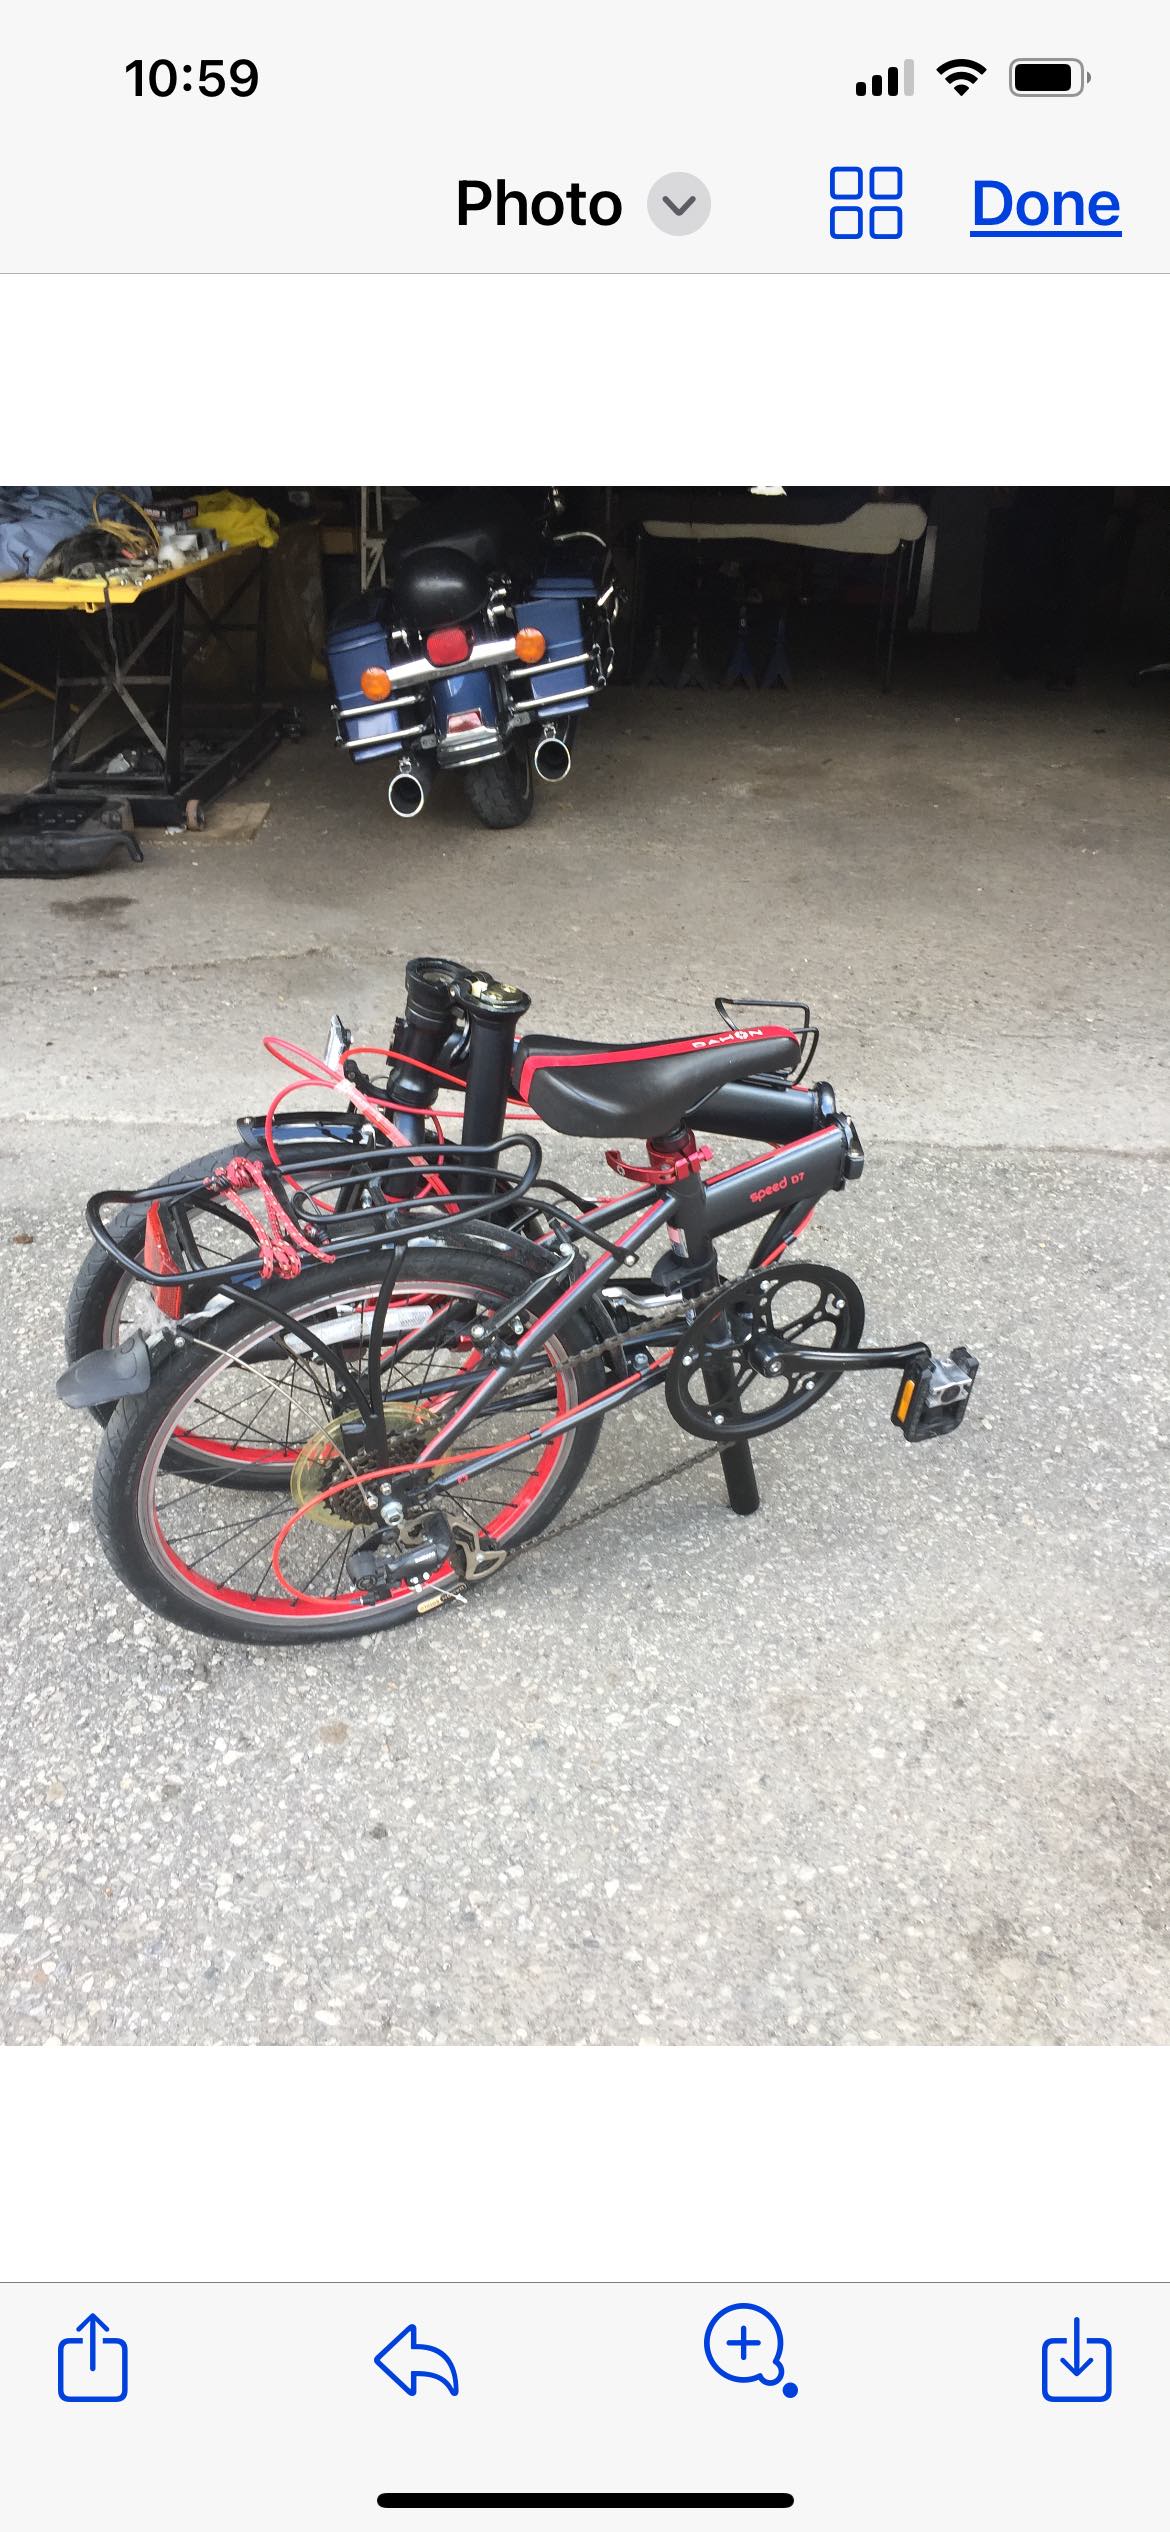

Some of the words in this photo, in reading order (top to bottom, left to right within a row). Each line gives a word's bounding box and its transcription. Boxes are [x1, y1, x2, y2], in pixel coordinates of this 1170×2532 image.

[125, 58, 259, 98] 10:59
[457, 178, 623, 228] Photo
[972, 179, 1122, 228] Done
